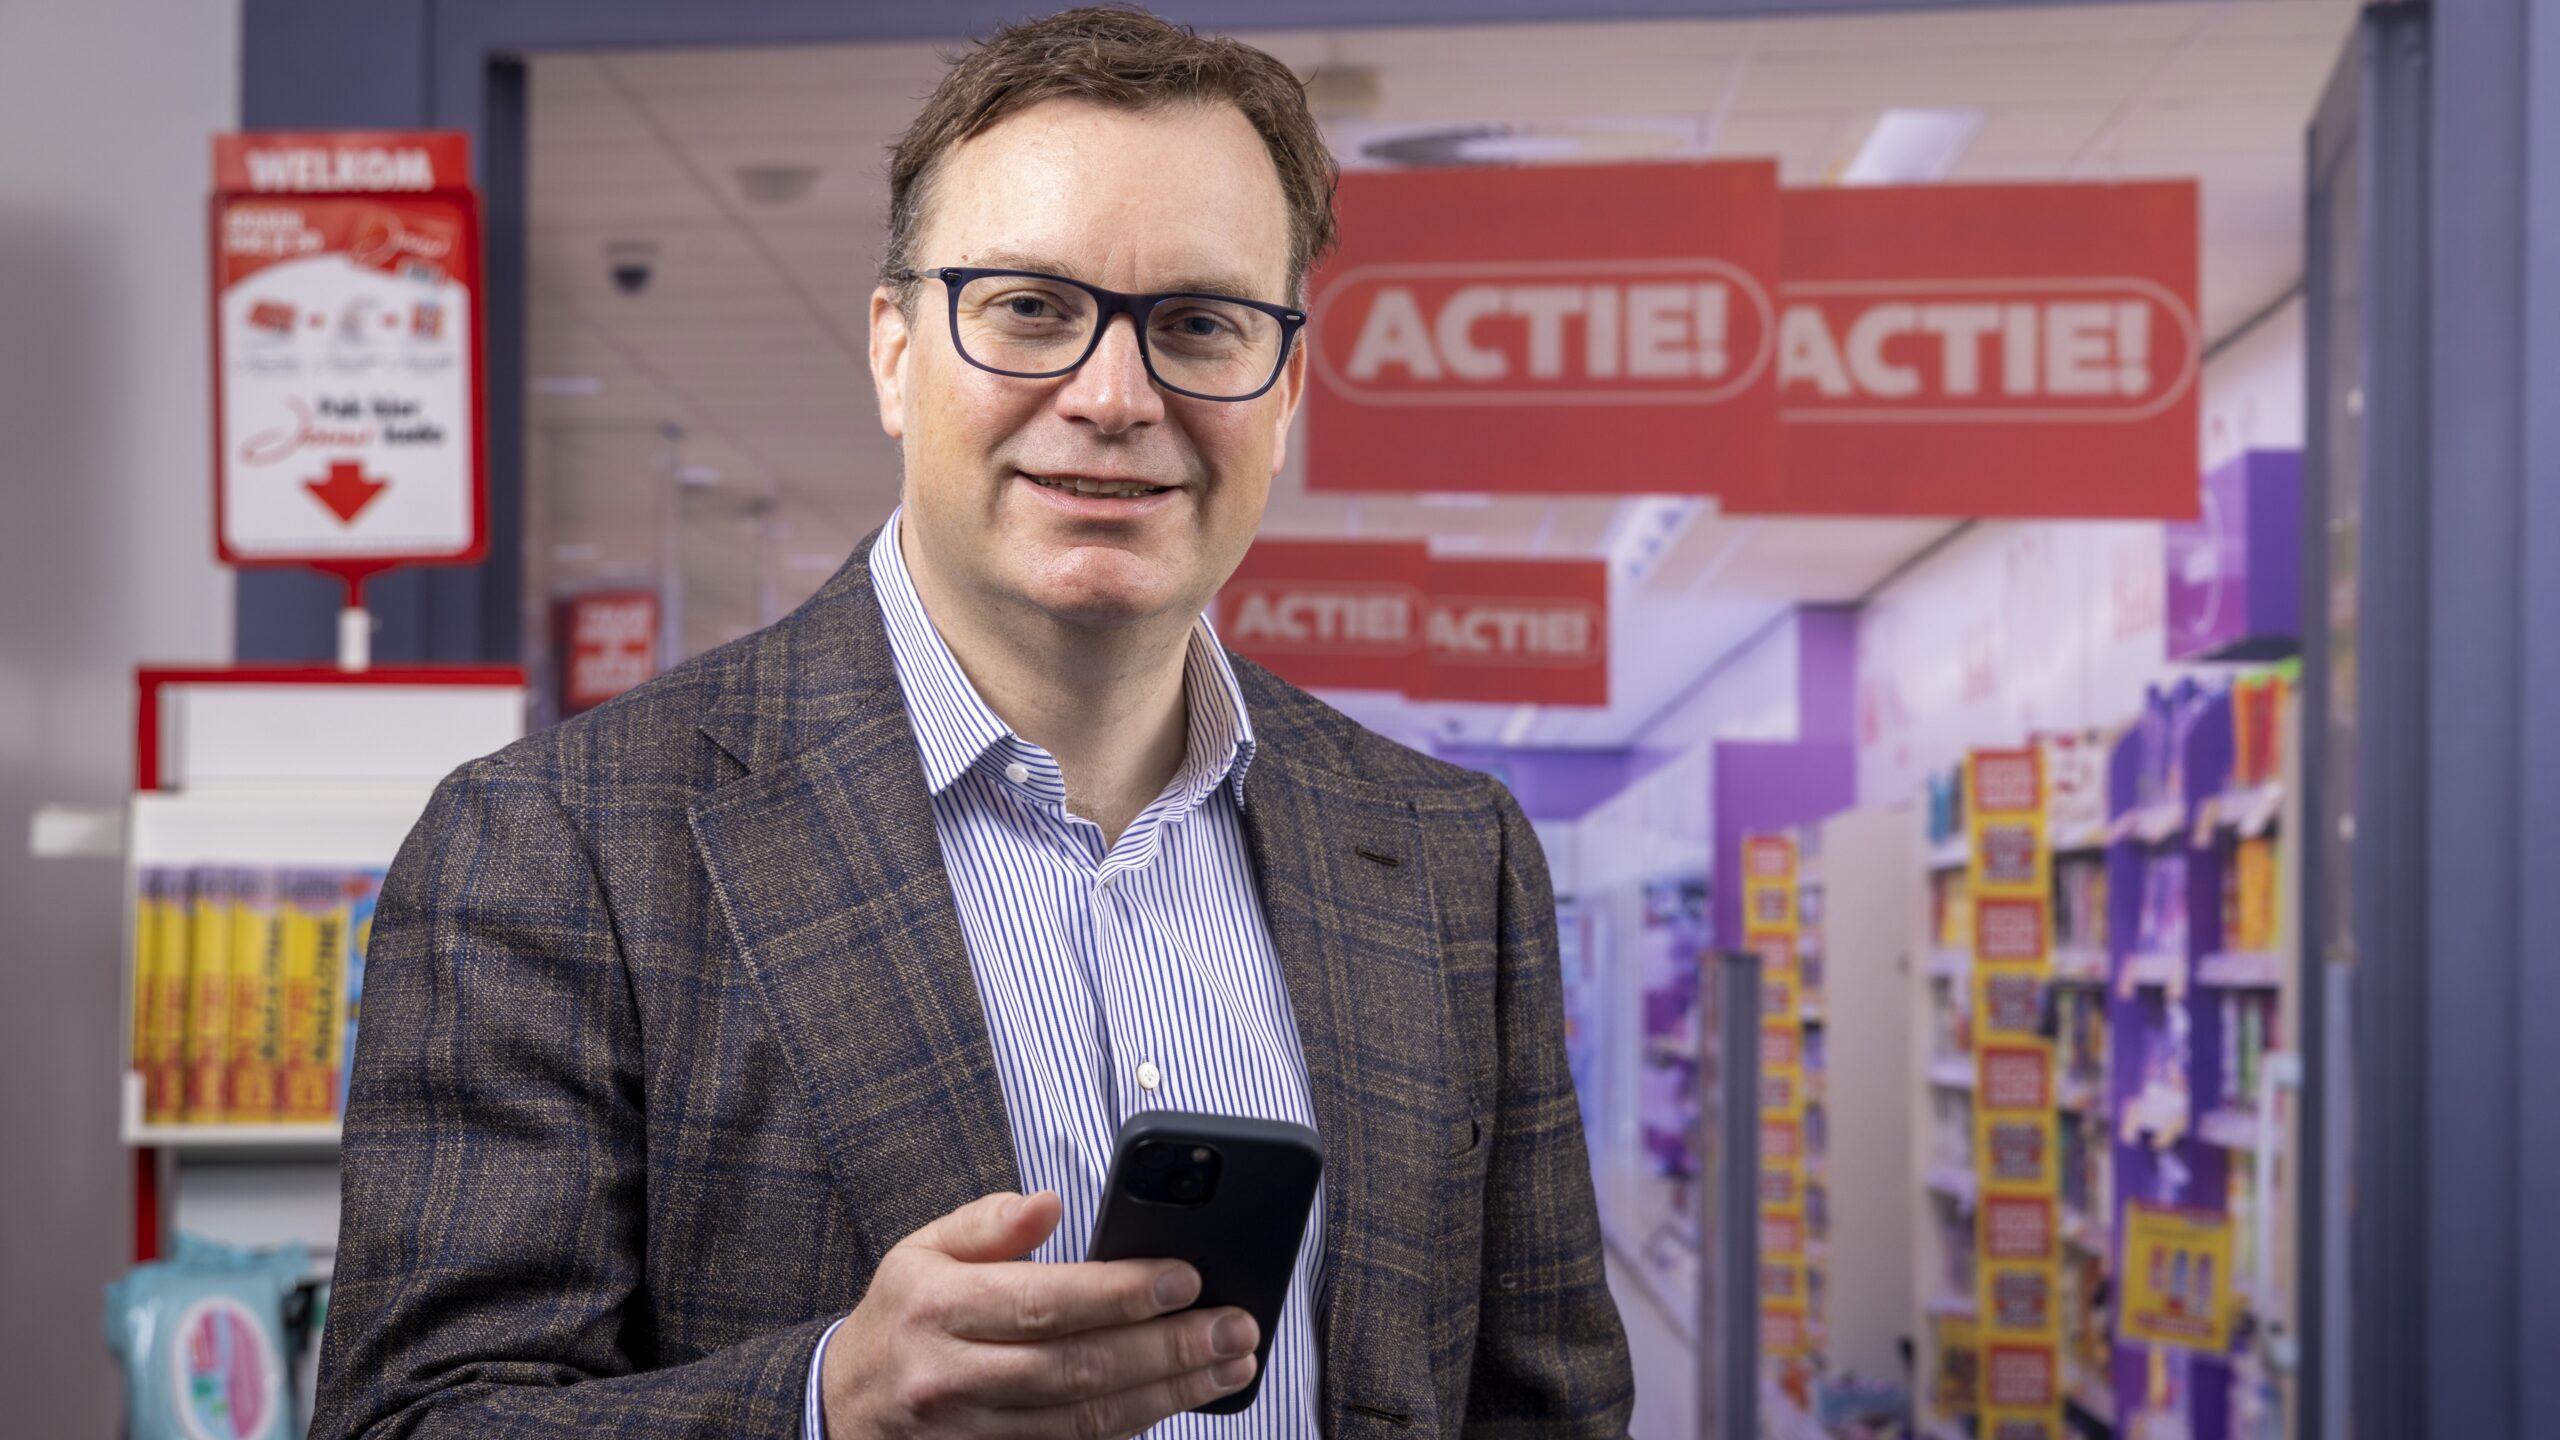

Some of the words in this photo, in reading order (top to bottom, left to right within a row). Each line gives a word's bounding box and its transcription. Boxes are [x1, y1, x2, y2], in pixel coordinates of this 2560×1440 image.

[245, 147, 434, 192] WELKOM
[1346, 282, 1730, 380] ACTIE!
[1779, 299, 2153, 397] ACTIE!
[1235, 592, 1411, 640] ACTIE!
[1427, 608, 1590, 654] ACTIE!
